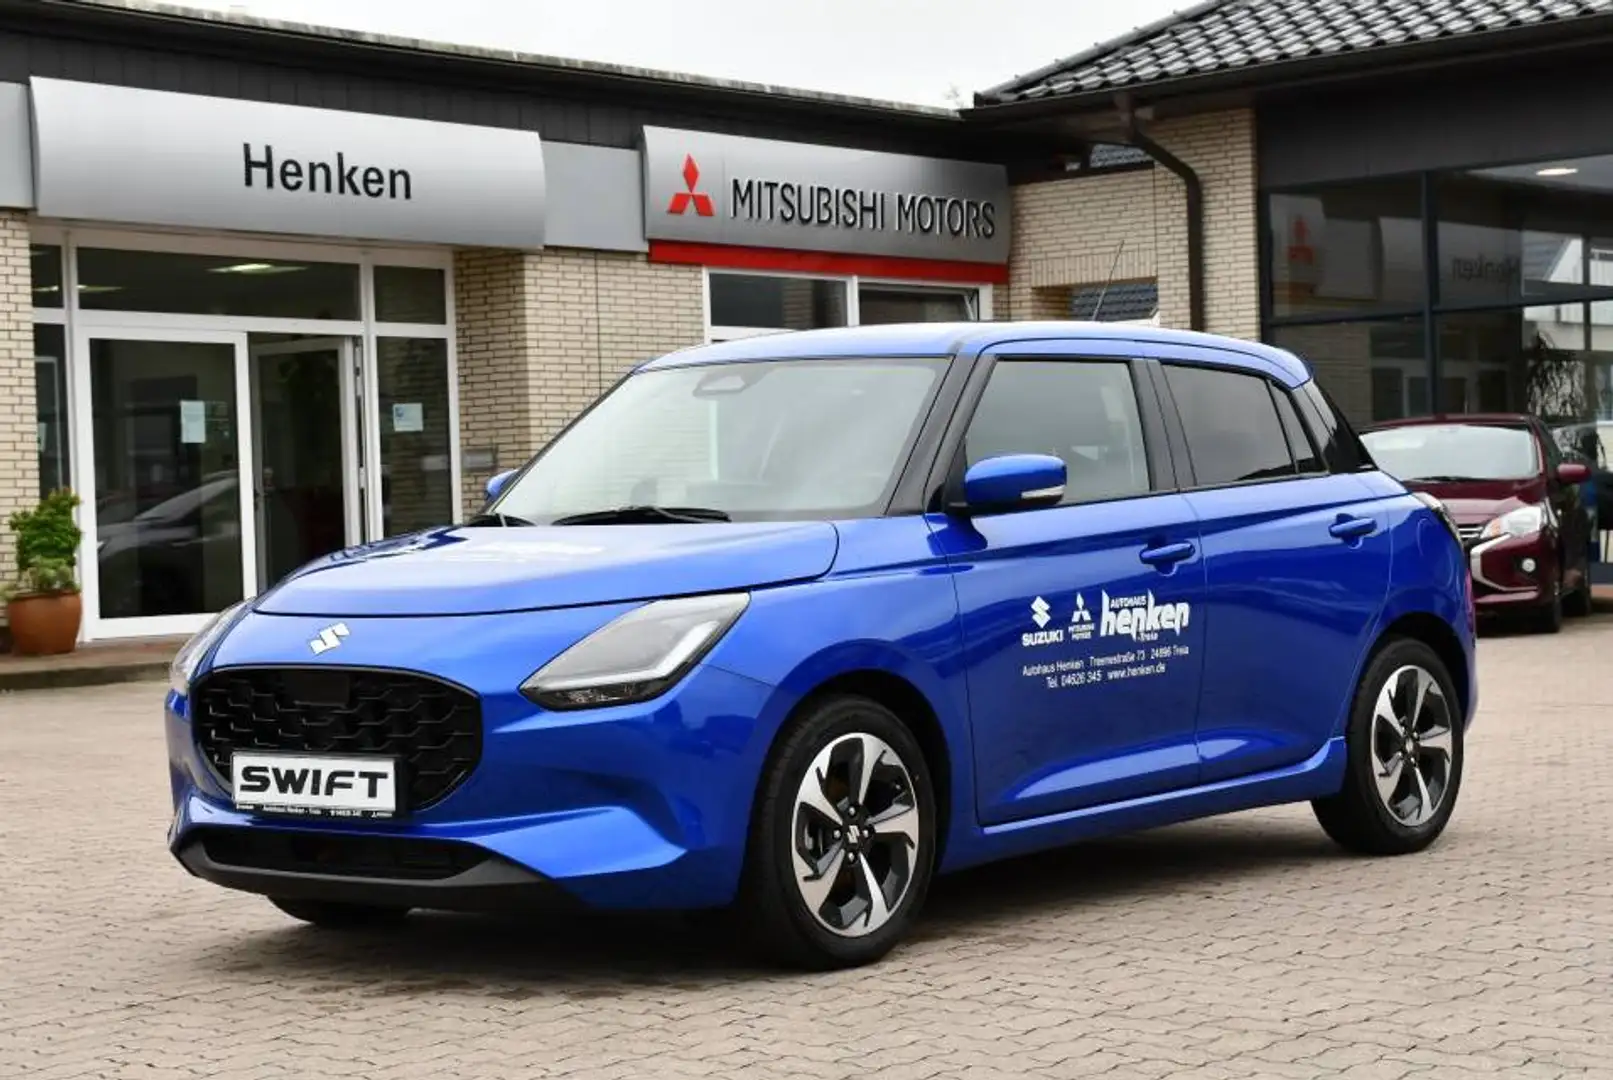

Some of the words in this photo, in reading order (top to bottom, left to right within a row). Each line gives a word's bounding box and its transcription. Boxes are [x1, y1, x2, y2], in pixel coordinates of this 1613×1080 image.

[243, 142, 412, 199] Henken
[730, 177, 884, 231] MITSUBISHI
[897, 193, 996, 239] MOTORS
[1100, 588, 1190, 642] henken
[1110, 595, 1146, 609] AUTOHAUS
[1021, 629, 1064, 647] SUZUKI
[1022, 663, 1055, 677] Autohaus
[1056, 659, 1084, 672] Henken
[1086, 669, 1102, 684] 345
[1107, 662, 1166, 681] www.henken.de
[239, 765, 389, 798] SWIFT
